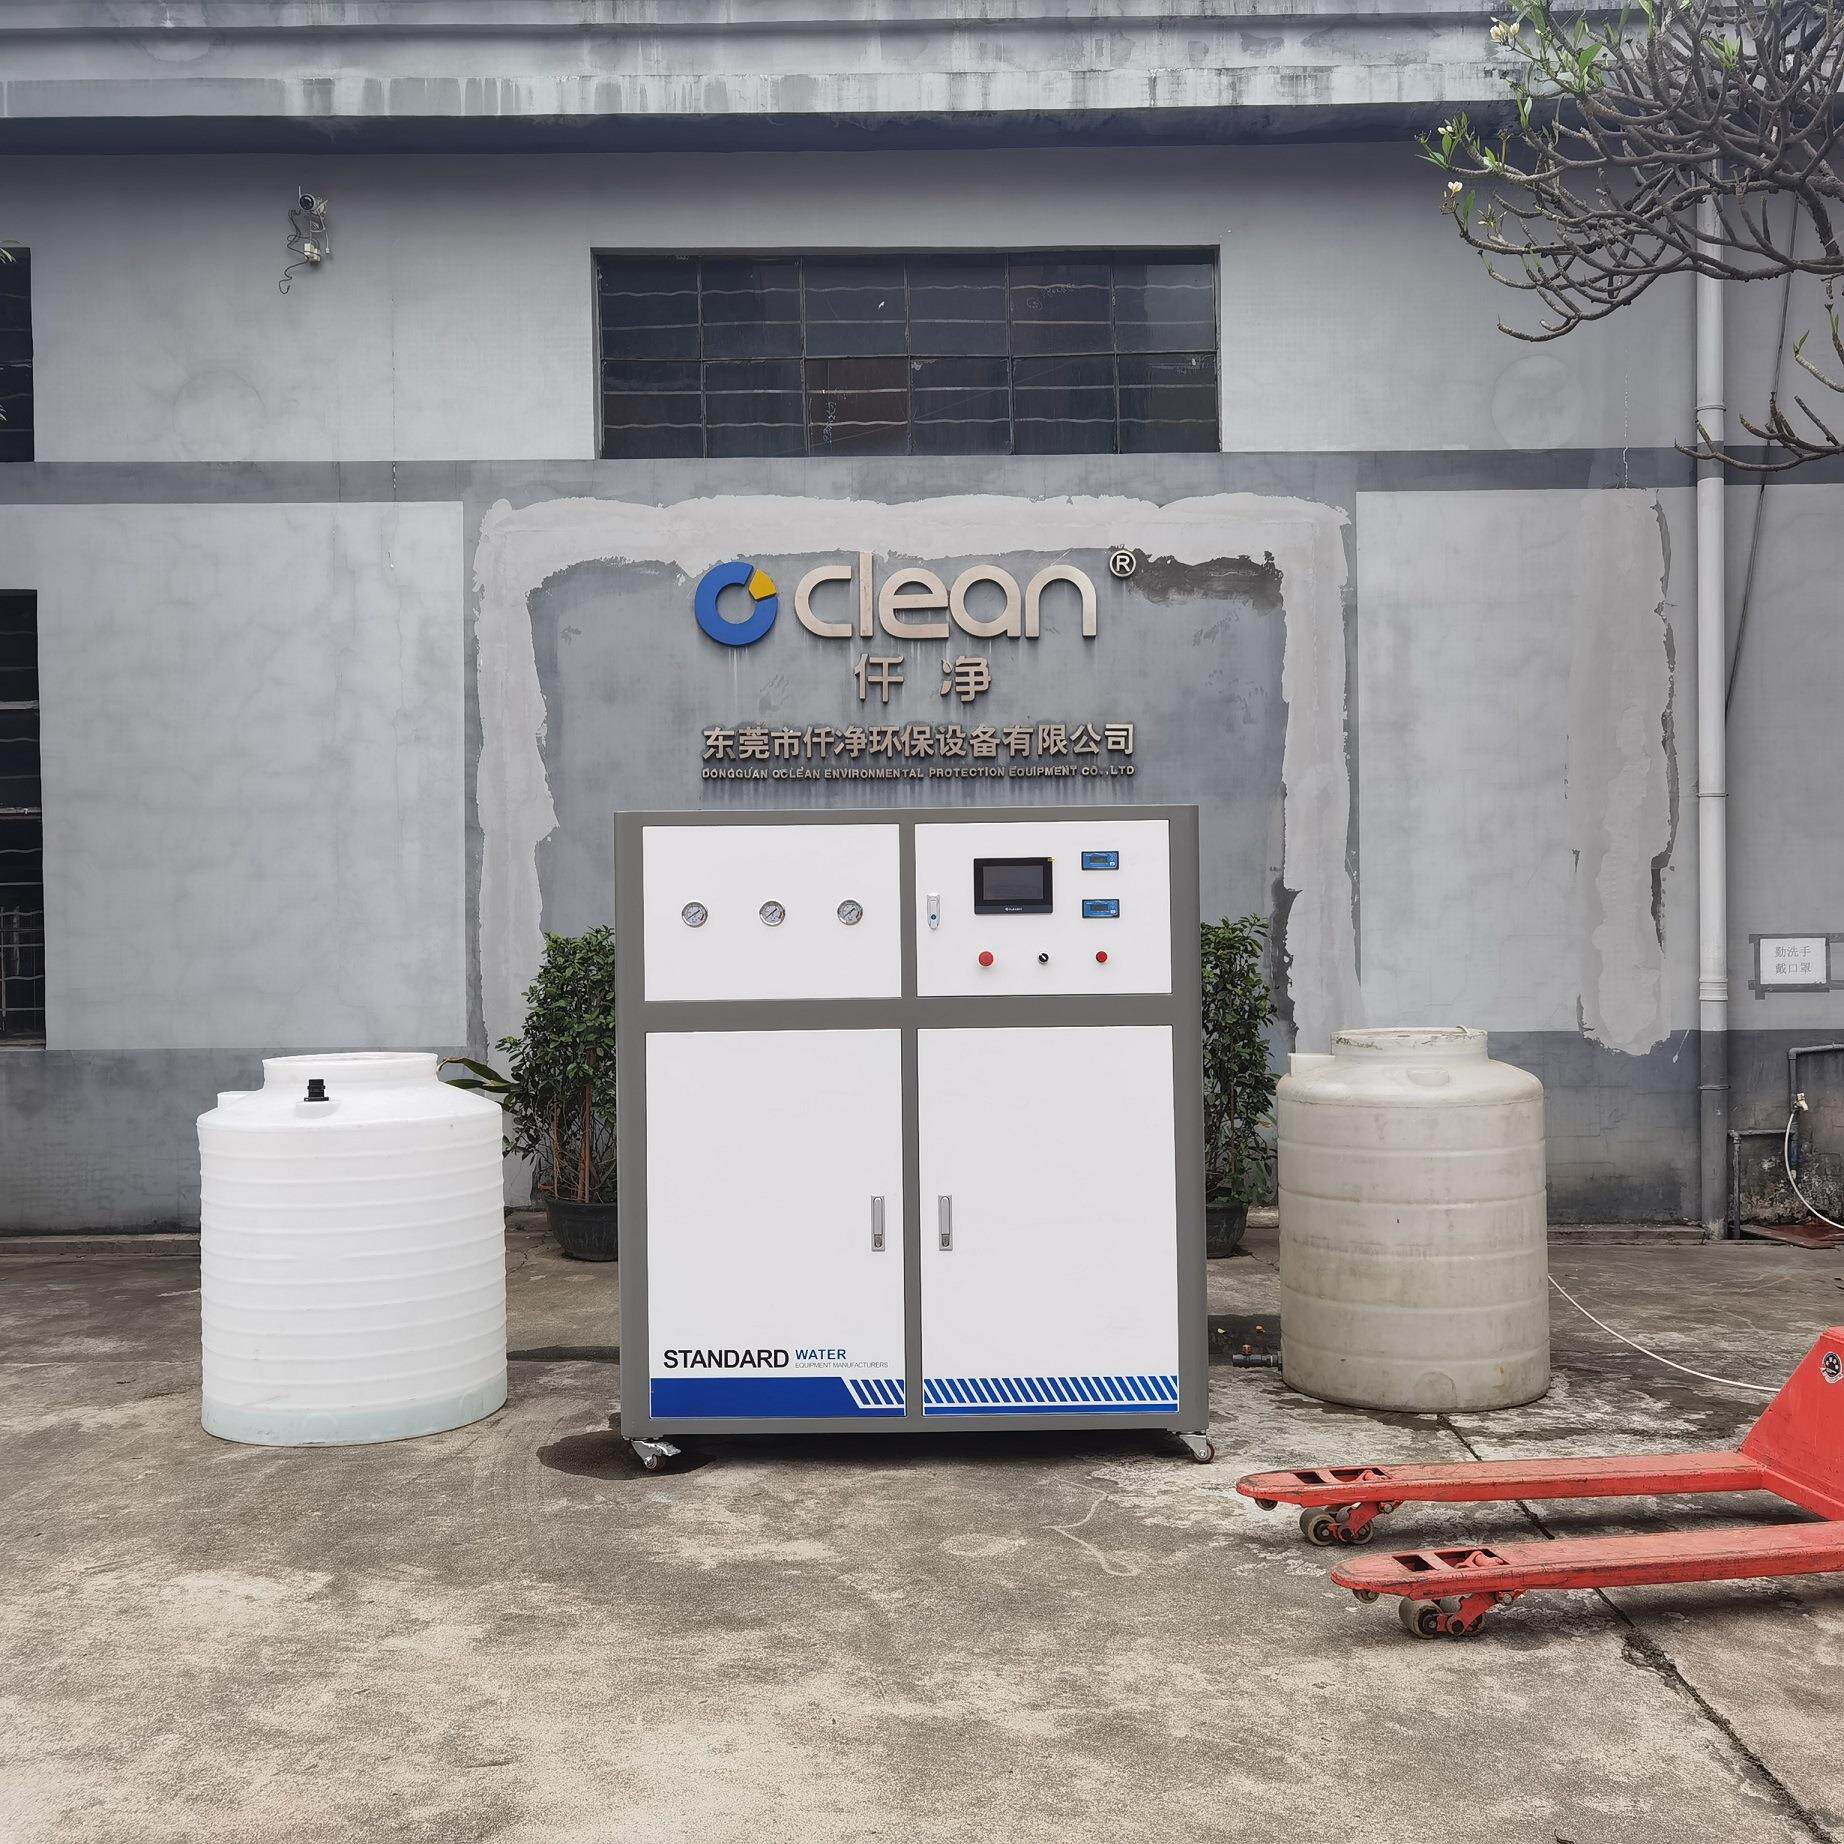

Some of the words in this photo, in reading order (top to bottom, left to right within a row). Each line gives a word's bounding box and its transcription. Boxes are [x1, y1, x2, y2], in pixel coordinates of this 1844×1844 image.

[702, 723, 1136, 761] 东莞市仟净环保设备有限公司
[702, 767, 768, 780] DONGGUAN
[772, 767, 820, 779] QCLEAN
[824, 767, 924, 779] ENVIRONMENTAL
[929, 766, 1005, 778] PROTECTION
[1009, 765, 1077, 777] EQUIPMENT
[1774, 945, 1811, 957] 勤洗手
[1775, 962, 1812, 974] 戴口罩
[662, 1348, 790, 1369] STANDARD
[795, 1348, 847, 1360] WATER
[794, 1361, 831, 1369] EQUIPMENT
[832, 1361, 889, 1369] MANUFACTURERS
